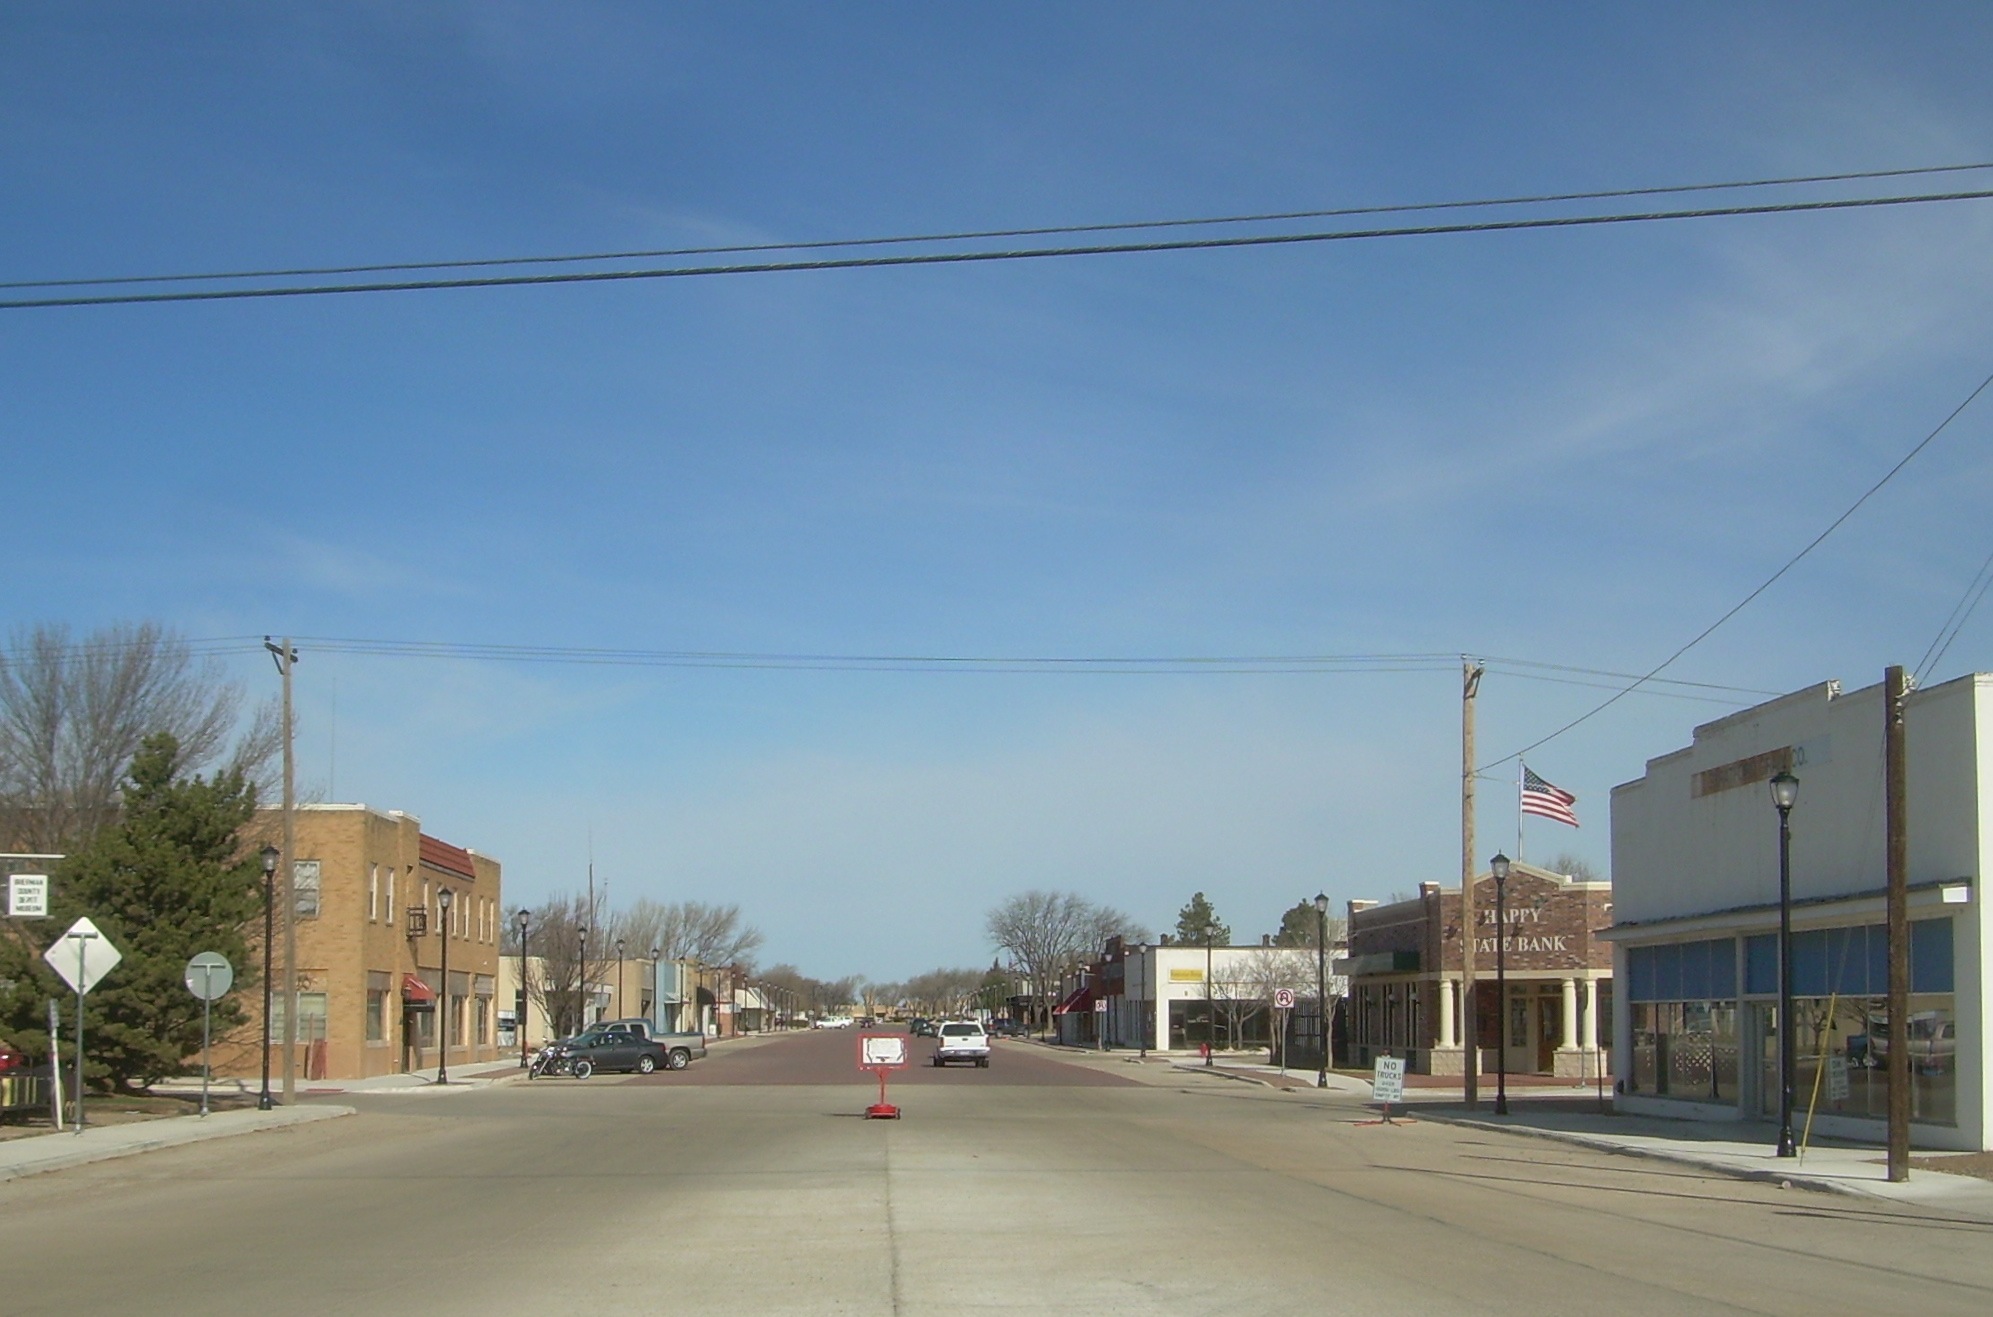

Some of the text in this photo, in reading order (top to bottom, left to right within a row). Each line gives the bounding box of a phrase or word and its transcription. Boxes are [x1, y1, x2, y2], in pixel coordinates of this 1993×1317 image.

[1484, 908, 1542, 924] HAPPY
[1460, 936, 1567, 953] TATE BANK
[1383, 1061, 1397, 1070] NO
[1376, 1071, 1402, 1081] TRUCKS
